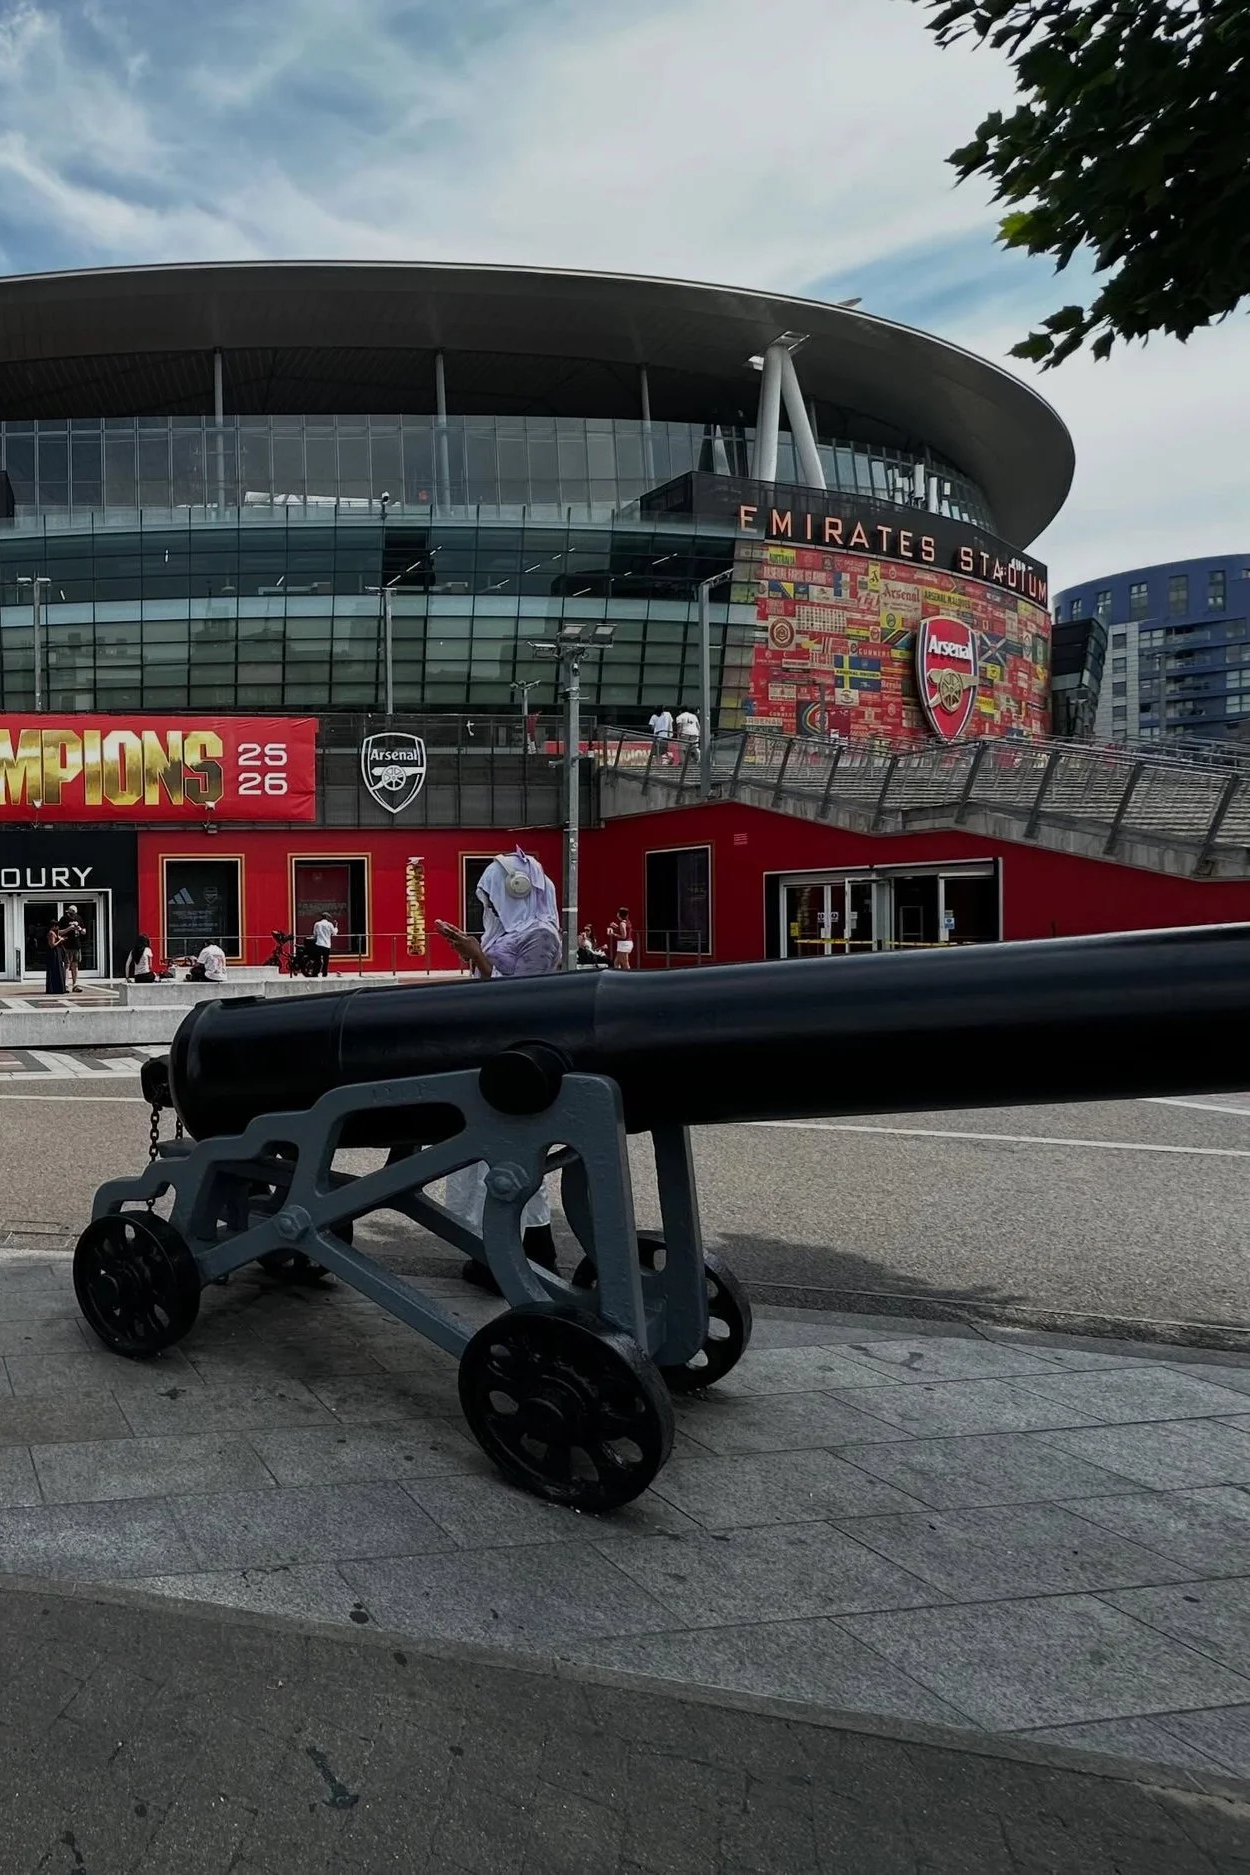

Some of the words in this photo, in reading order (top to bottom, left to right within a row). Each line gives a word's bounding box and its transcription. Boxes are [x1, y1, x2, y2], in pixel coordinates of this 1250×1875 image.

[740, 505, 935, 562] EMIRATES
[960, 546, 1047, 602] STADIUM
[881, 581, 920, 602] Arsenal
[928, 635, 972, 660] Arsenal
[238, 743, 288, 766] 25
[370, 748, 418, 761] Arsenal
[238, 772, 288, 796] 26
[406, 864, 426, 956] CHAMPIONS
